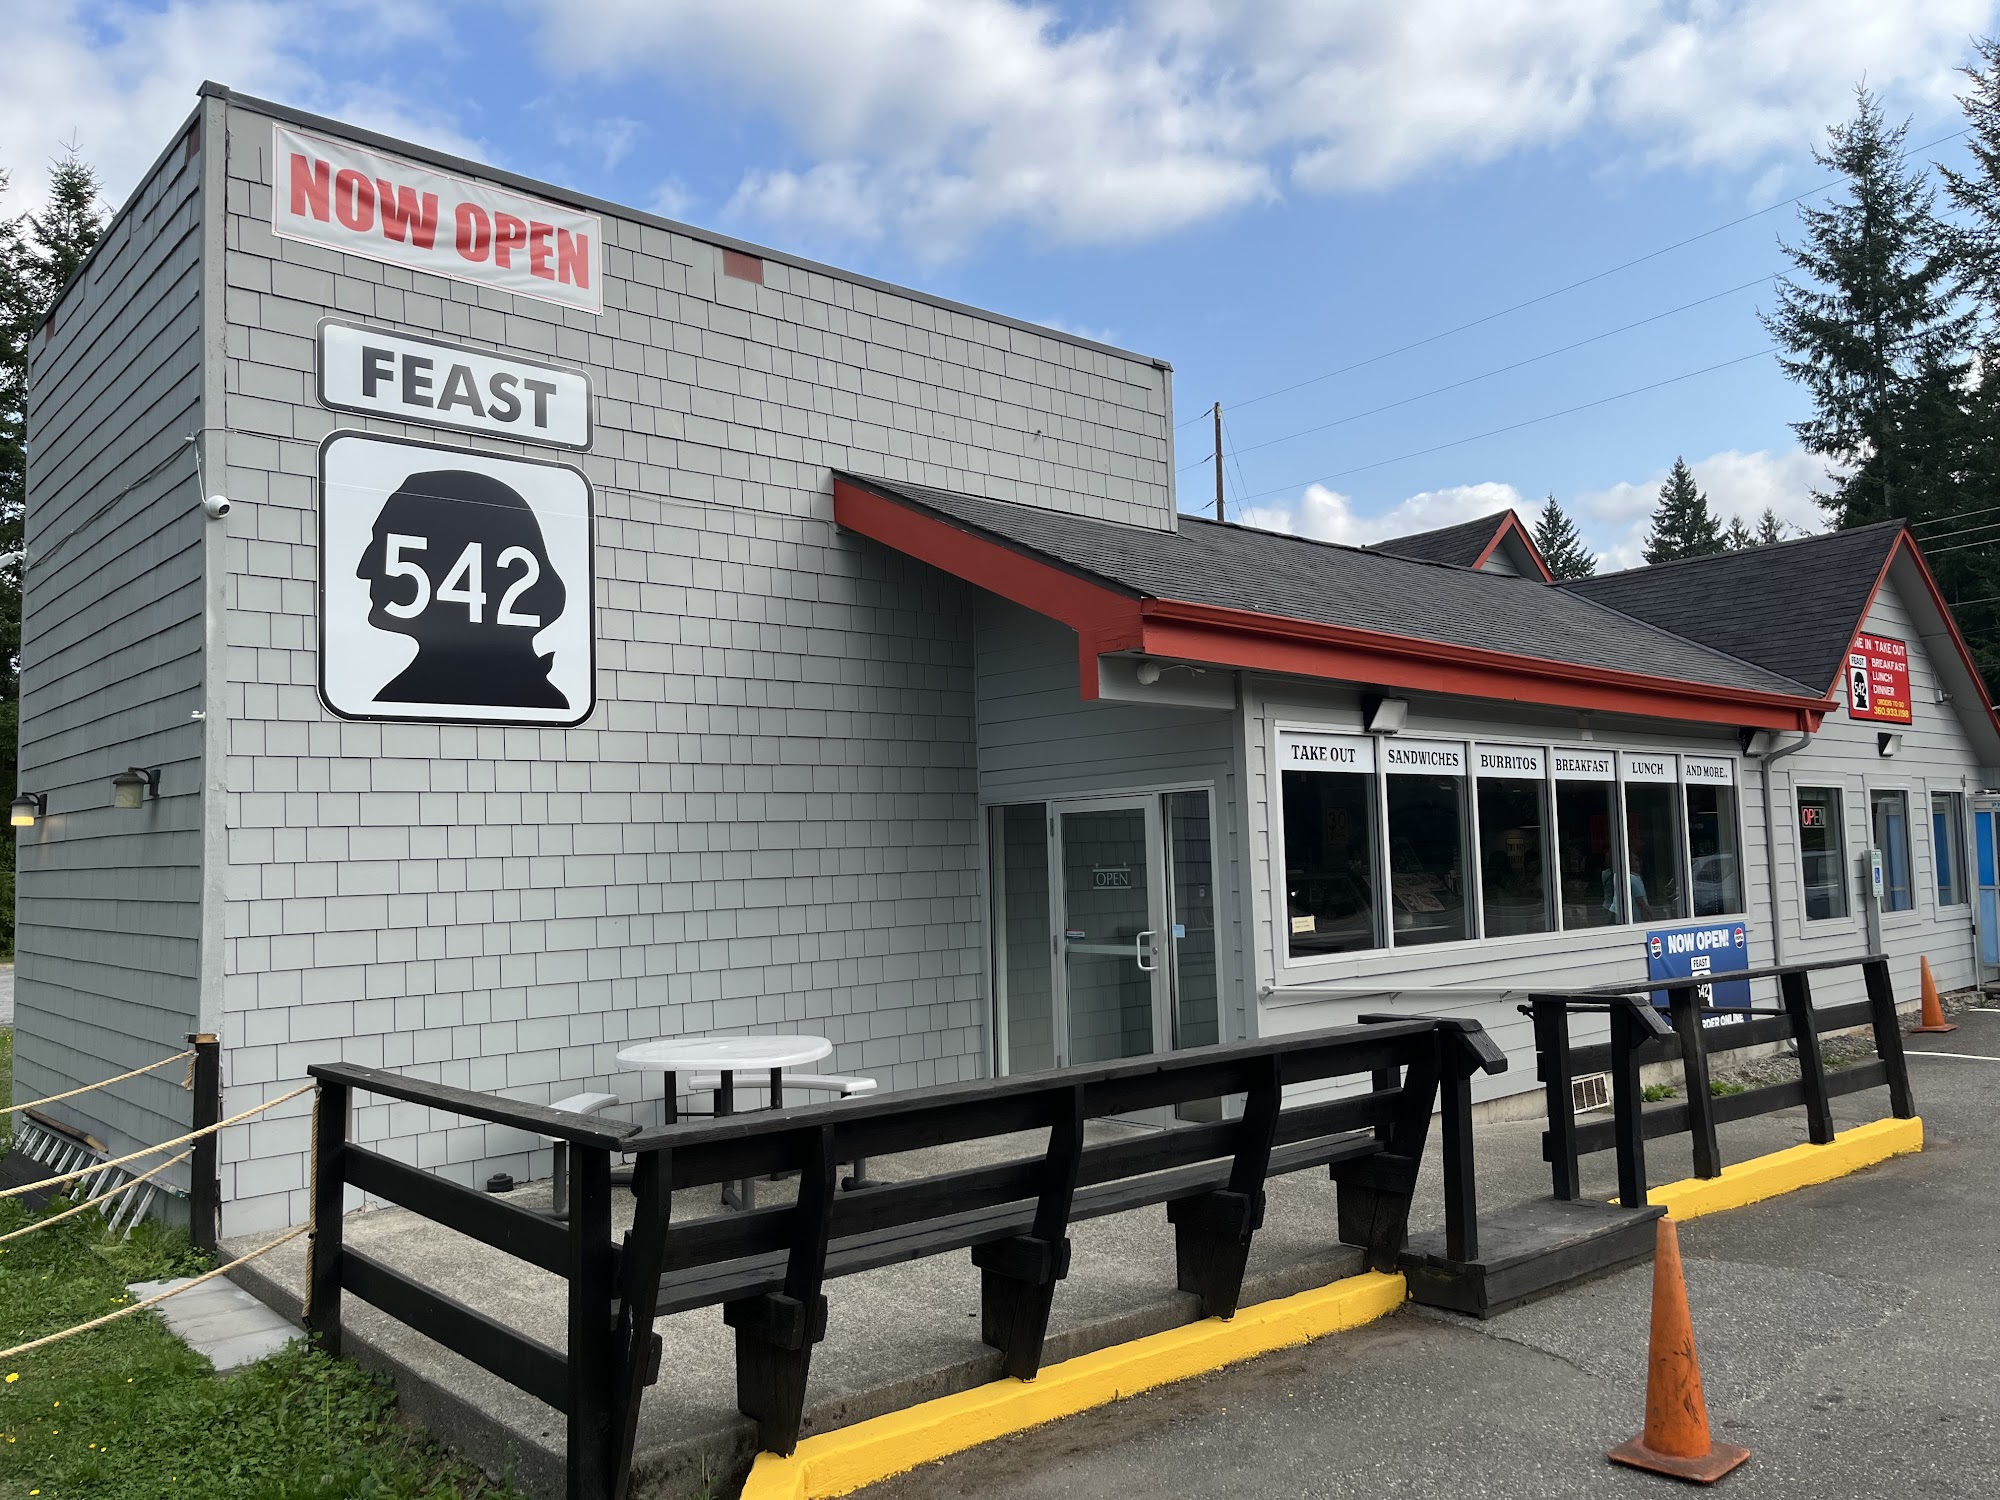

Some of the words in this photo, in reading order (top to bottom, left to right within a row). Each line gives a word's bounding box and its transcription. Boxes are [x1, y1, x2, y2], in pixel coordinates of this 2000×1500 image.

[290, 153, 439, 250] NOW
[455, 202, 589, 290] OPEN
[362, 346, 556, 428] FEAST
[383, 533, 540, 627] 542
[1854, 637, 1864, 649] NE
[1865, 639, 1872, 651] IN
[1874, 641, 1892, 655] TAKE
[1892, 645, 1905, 657] OUT
[1851, 656, 1864, 666] FEAST
[1871, 657, 1906, 672] BREAKFAST
[1872, 671, 1893, 683] LUNCH
[1854, 681, 1866, 696] 542
[1873, 684, 1895, 696] DINNER
[1291, 744, 1327, 761] TAKE
[1330, 747, 1356, 763] OUT
[1388, 749, 1459, 767] SANDWICHES
[1481, 754, 1537, 770] BURRITOS
[1555, 758, 1609, 773] BREAKFAST
[1632, 762, 1664, 775] LUNCH
[1686, 764, 1702, 776] AND
[1803, 808, 1825, 825] OPEN
[1096, 872, 1128, 886] OPEN
[1667, 933, 1694, 954] NOW
[1696, 929, 1729, 950] OPEN!
[1693, 958, 1707, 968] FEAST
[1702, 1016, 1719, 1029] RDER
[1720, 1013, 1744, 1026] ONLINE
